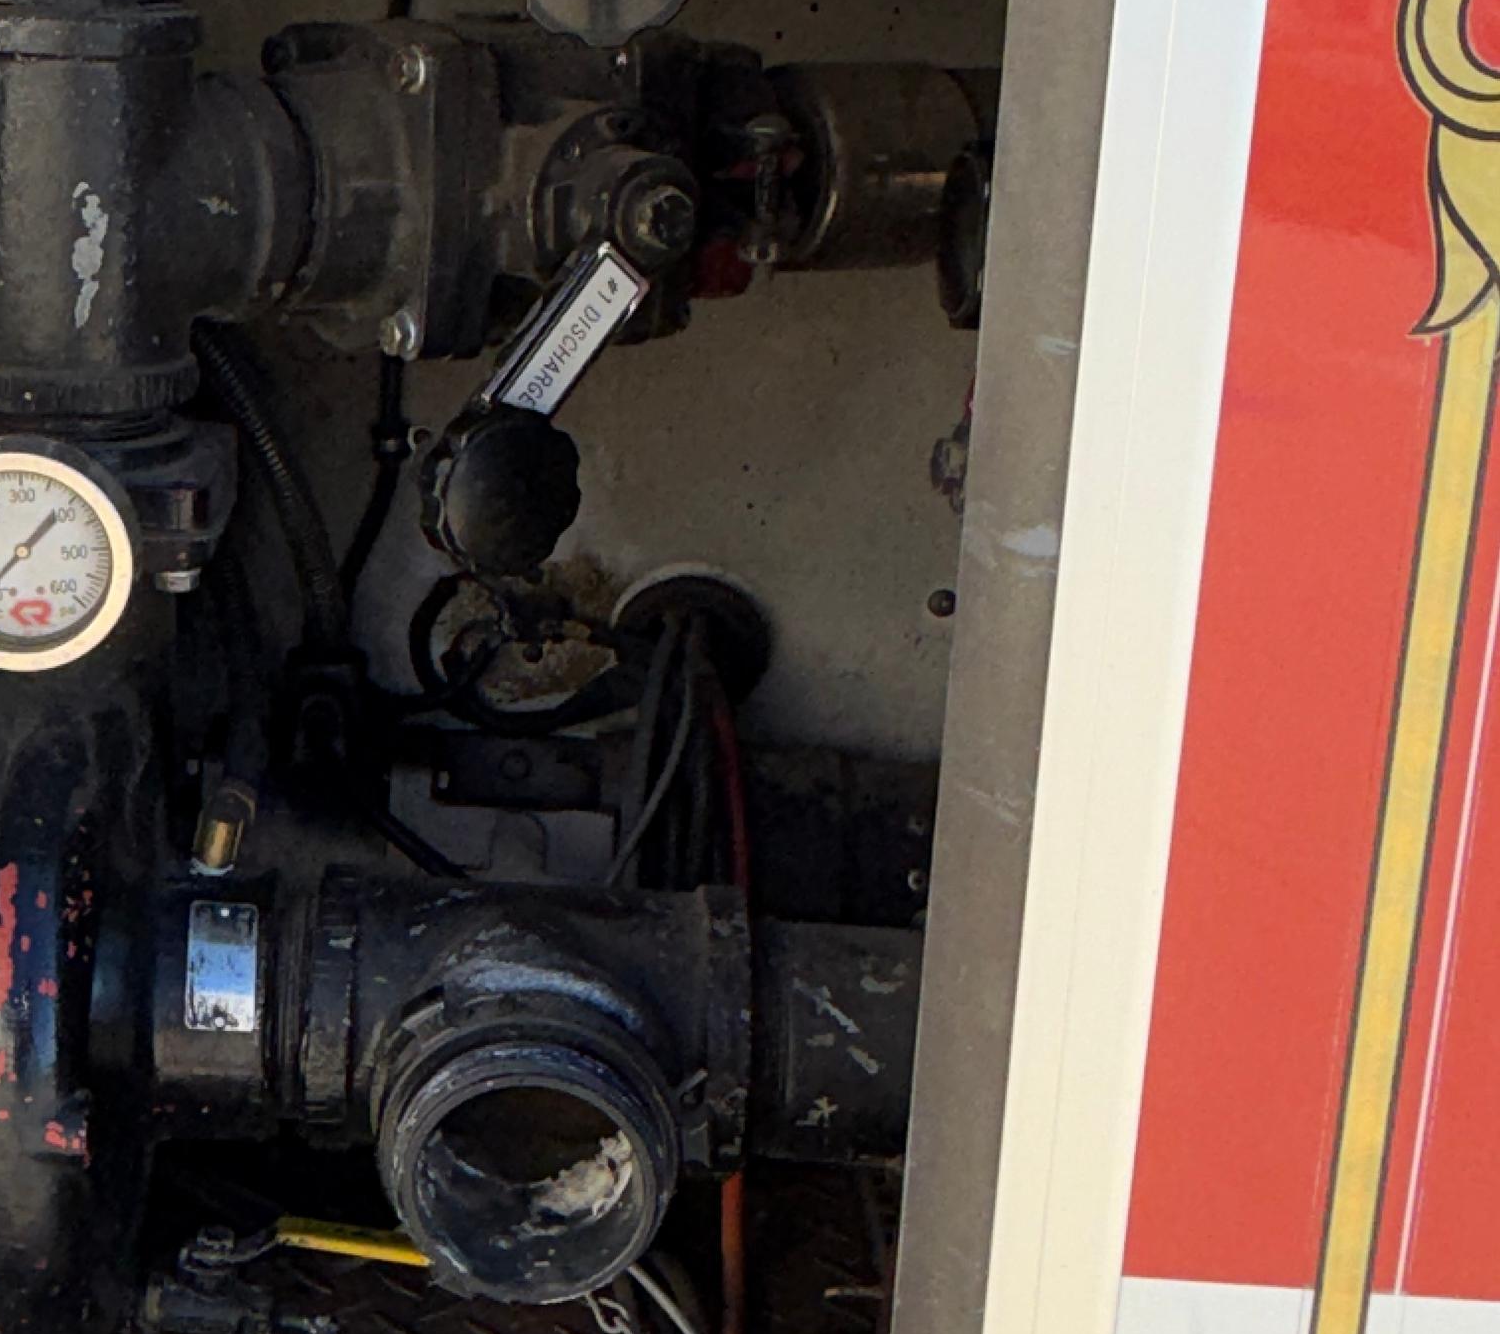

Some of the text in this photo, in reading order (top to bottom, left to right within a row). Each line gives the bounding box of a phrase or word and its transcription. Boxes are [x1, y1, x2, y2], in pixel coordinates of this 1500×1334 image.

[518, 276, 620, 407] #1 DISCHARGE
[8, 489, 36, 503] 300
[53, 507, 76, 522] 00
[61, 545, 88, 560] 500
[50, 579, 77, 595] 600
